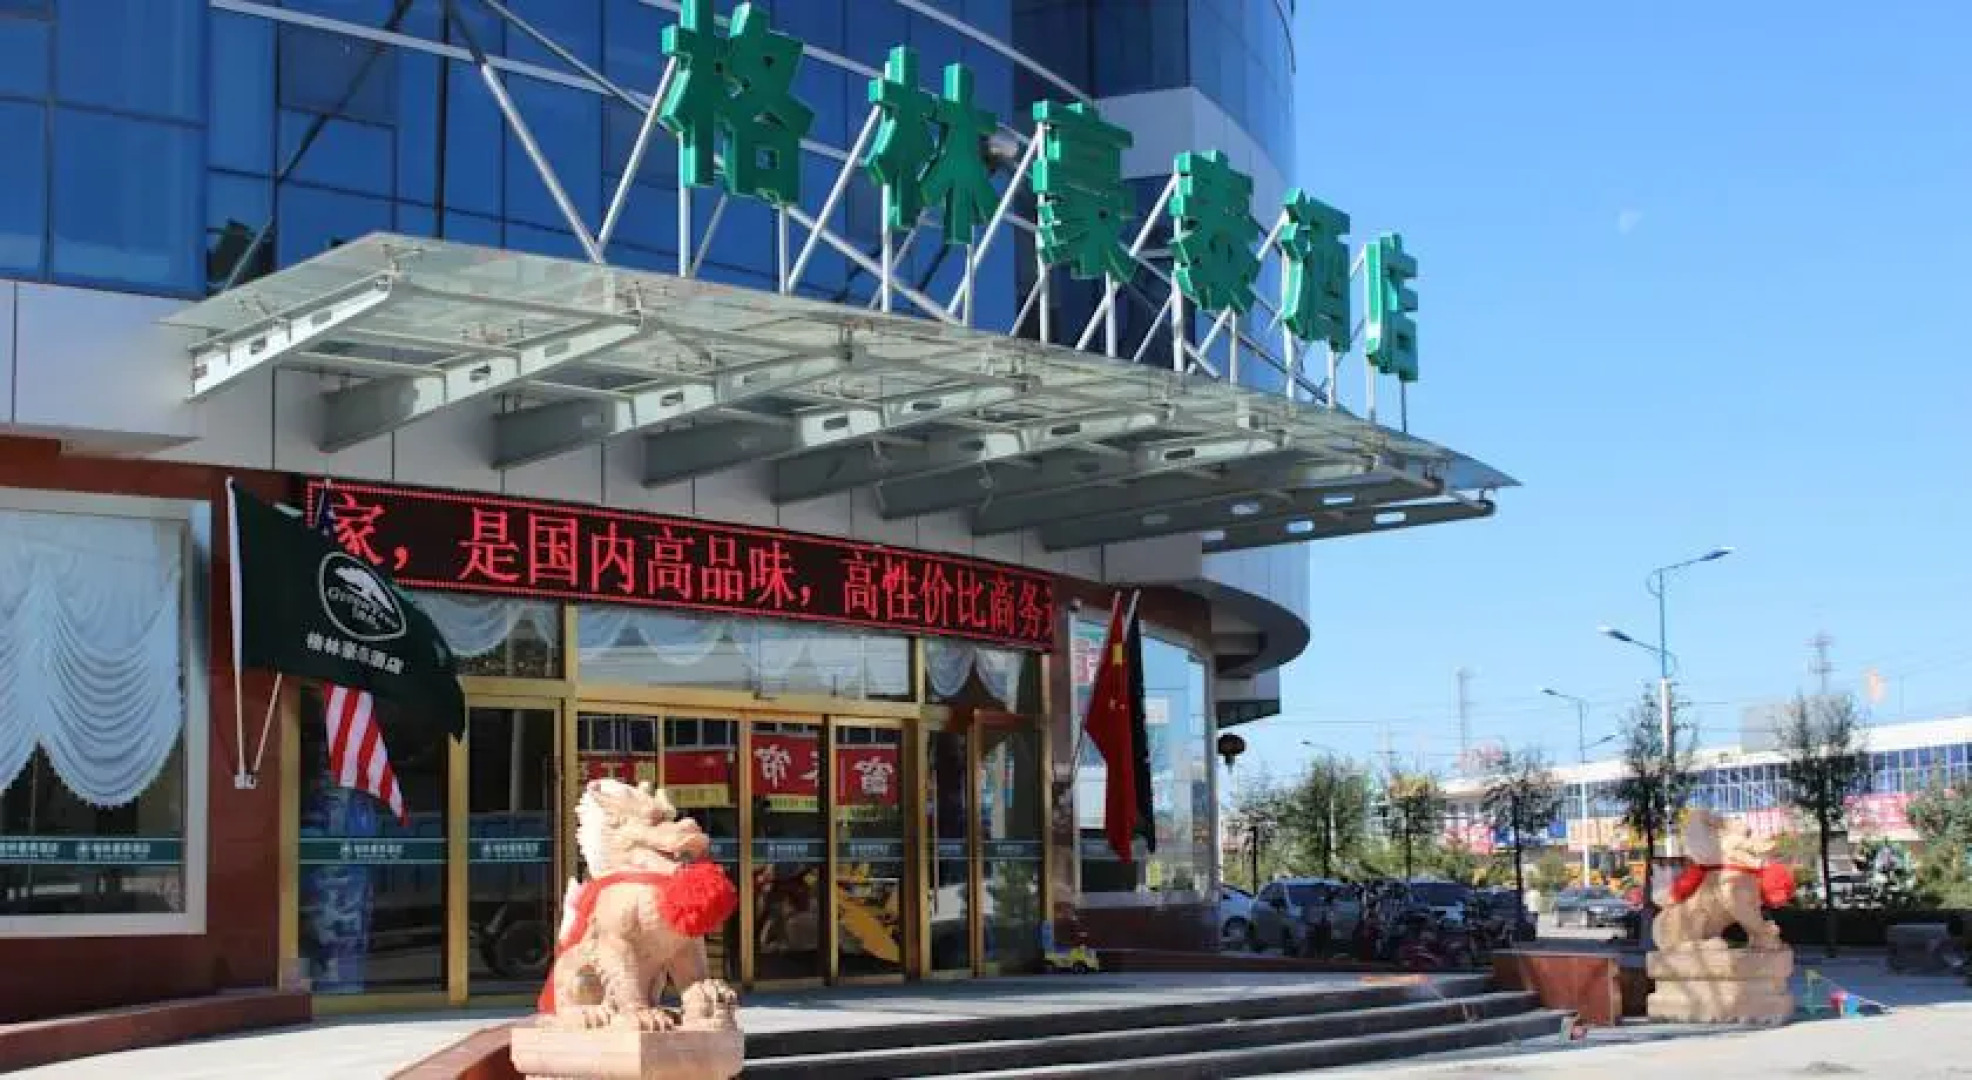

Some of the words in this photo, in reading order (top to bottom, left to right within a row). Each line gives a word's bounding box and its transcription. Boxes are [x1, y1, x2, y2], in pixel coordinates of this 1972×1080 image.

[660, 0, 1419, 382] 格林豪泰酒店
